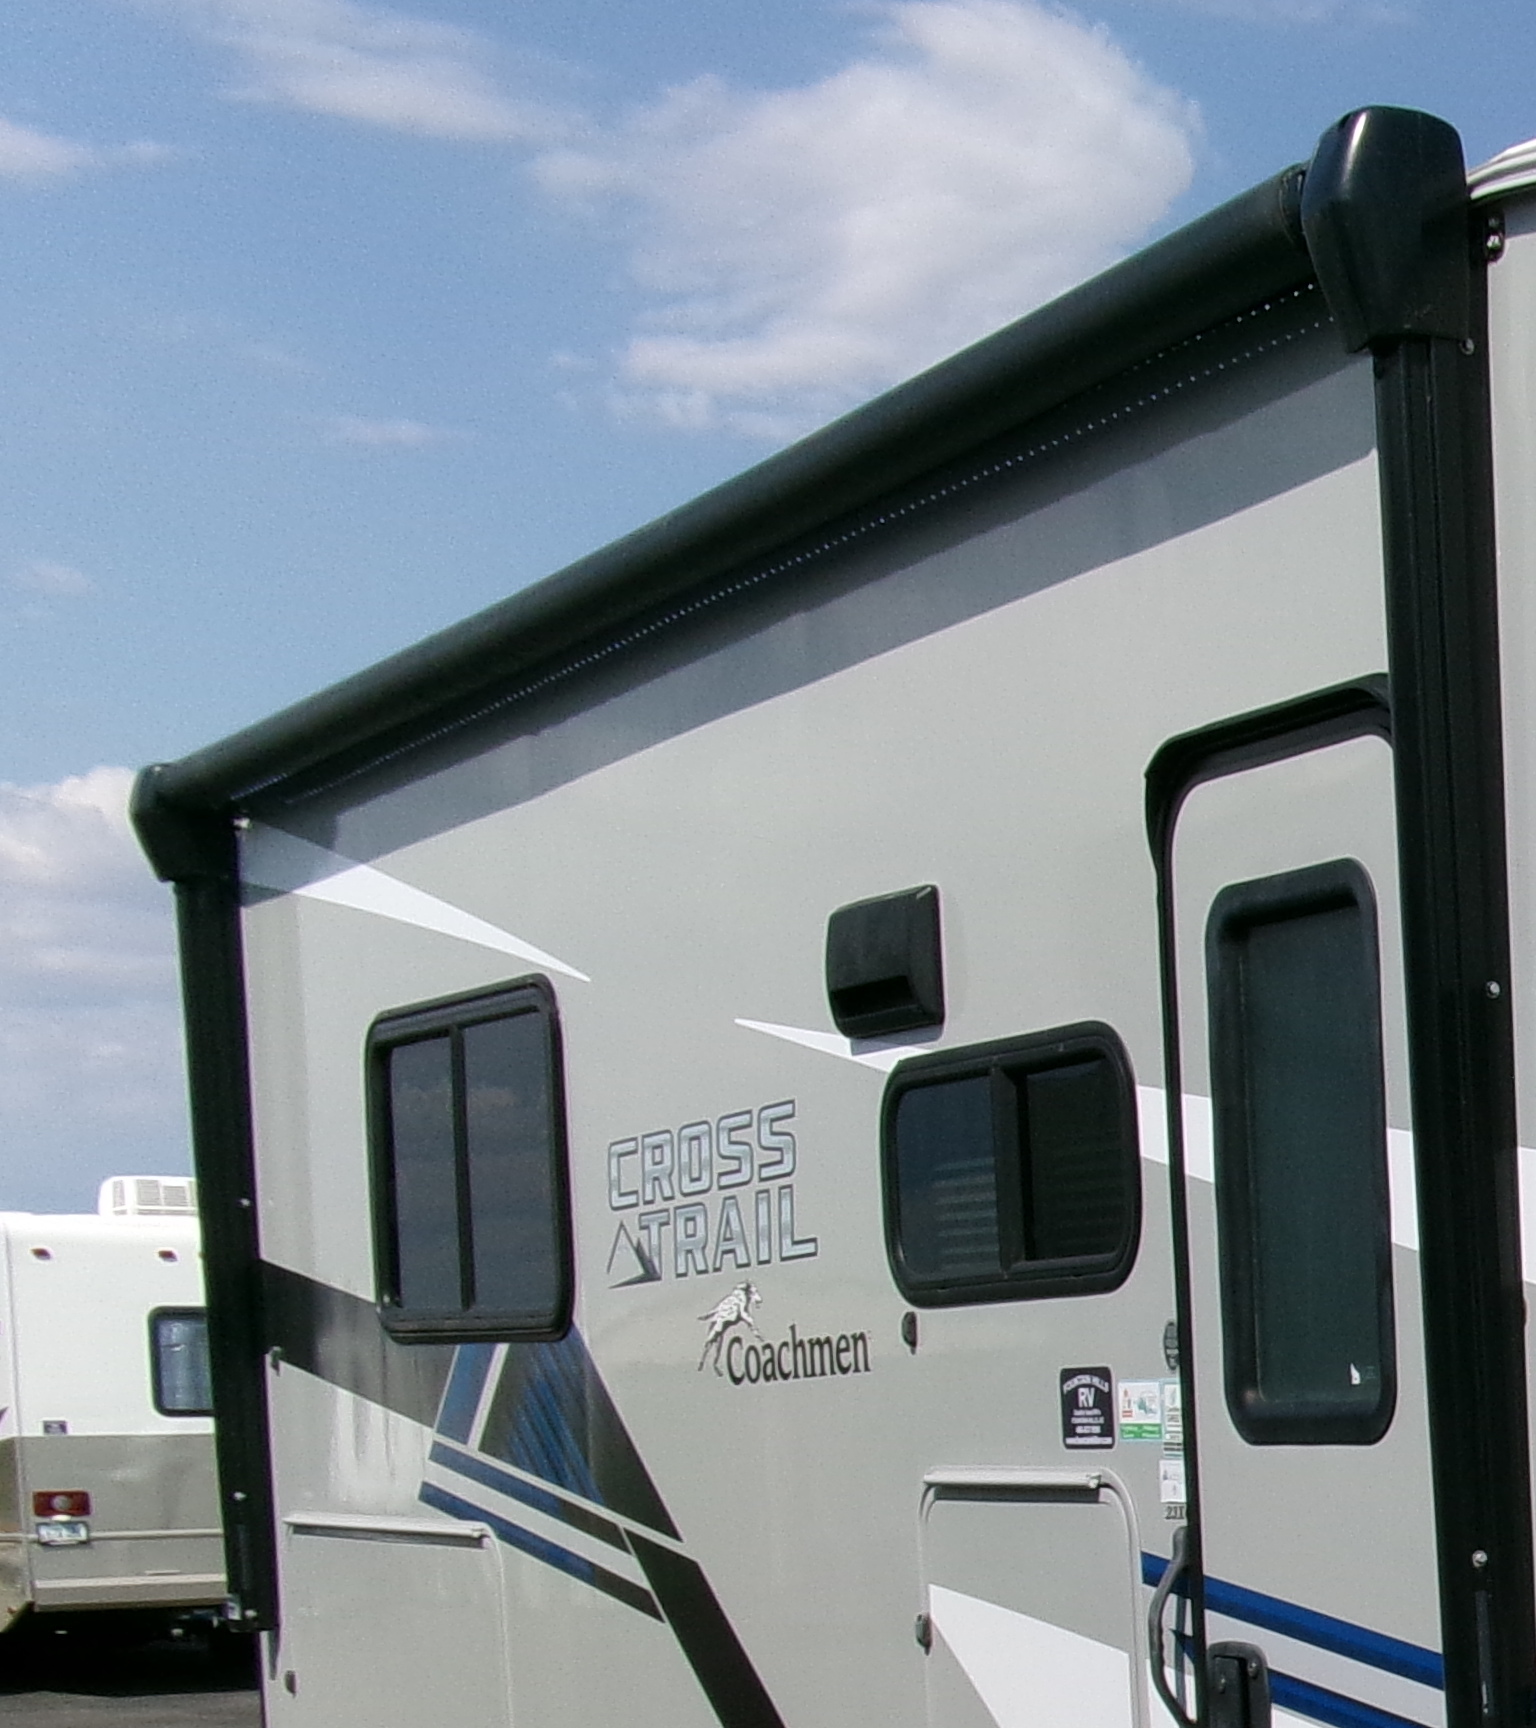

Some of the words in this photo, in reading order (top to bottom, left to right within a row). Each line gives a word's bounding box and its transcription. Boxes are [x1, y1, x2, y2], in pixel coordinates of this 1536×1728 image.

[607, 1098, 796, 1211] CROSS
[638, 1184, 818, 1281] TRAIL
[726, 1323, 871, 1386] Coachmen
[1078, 1387, 1095, 1408] RV
